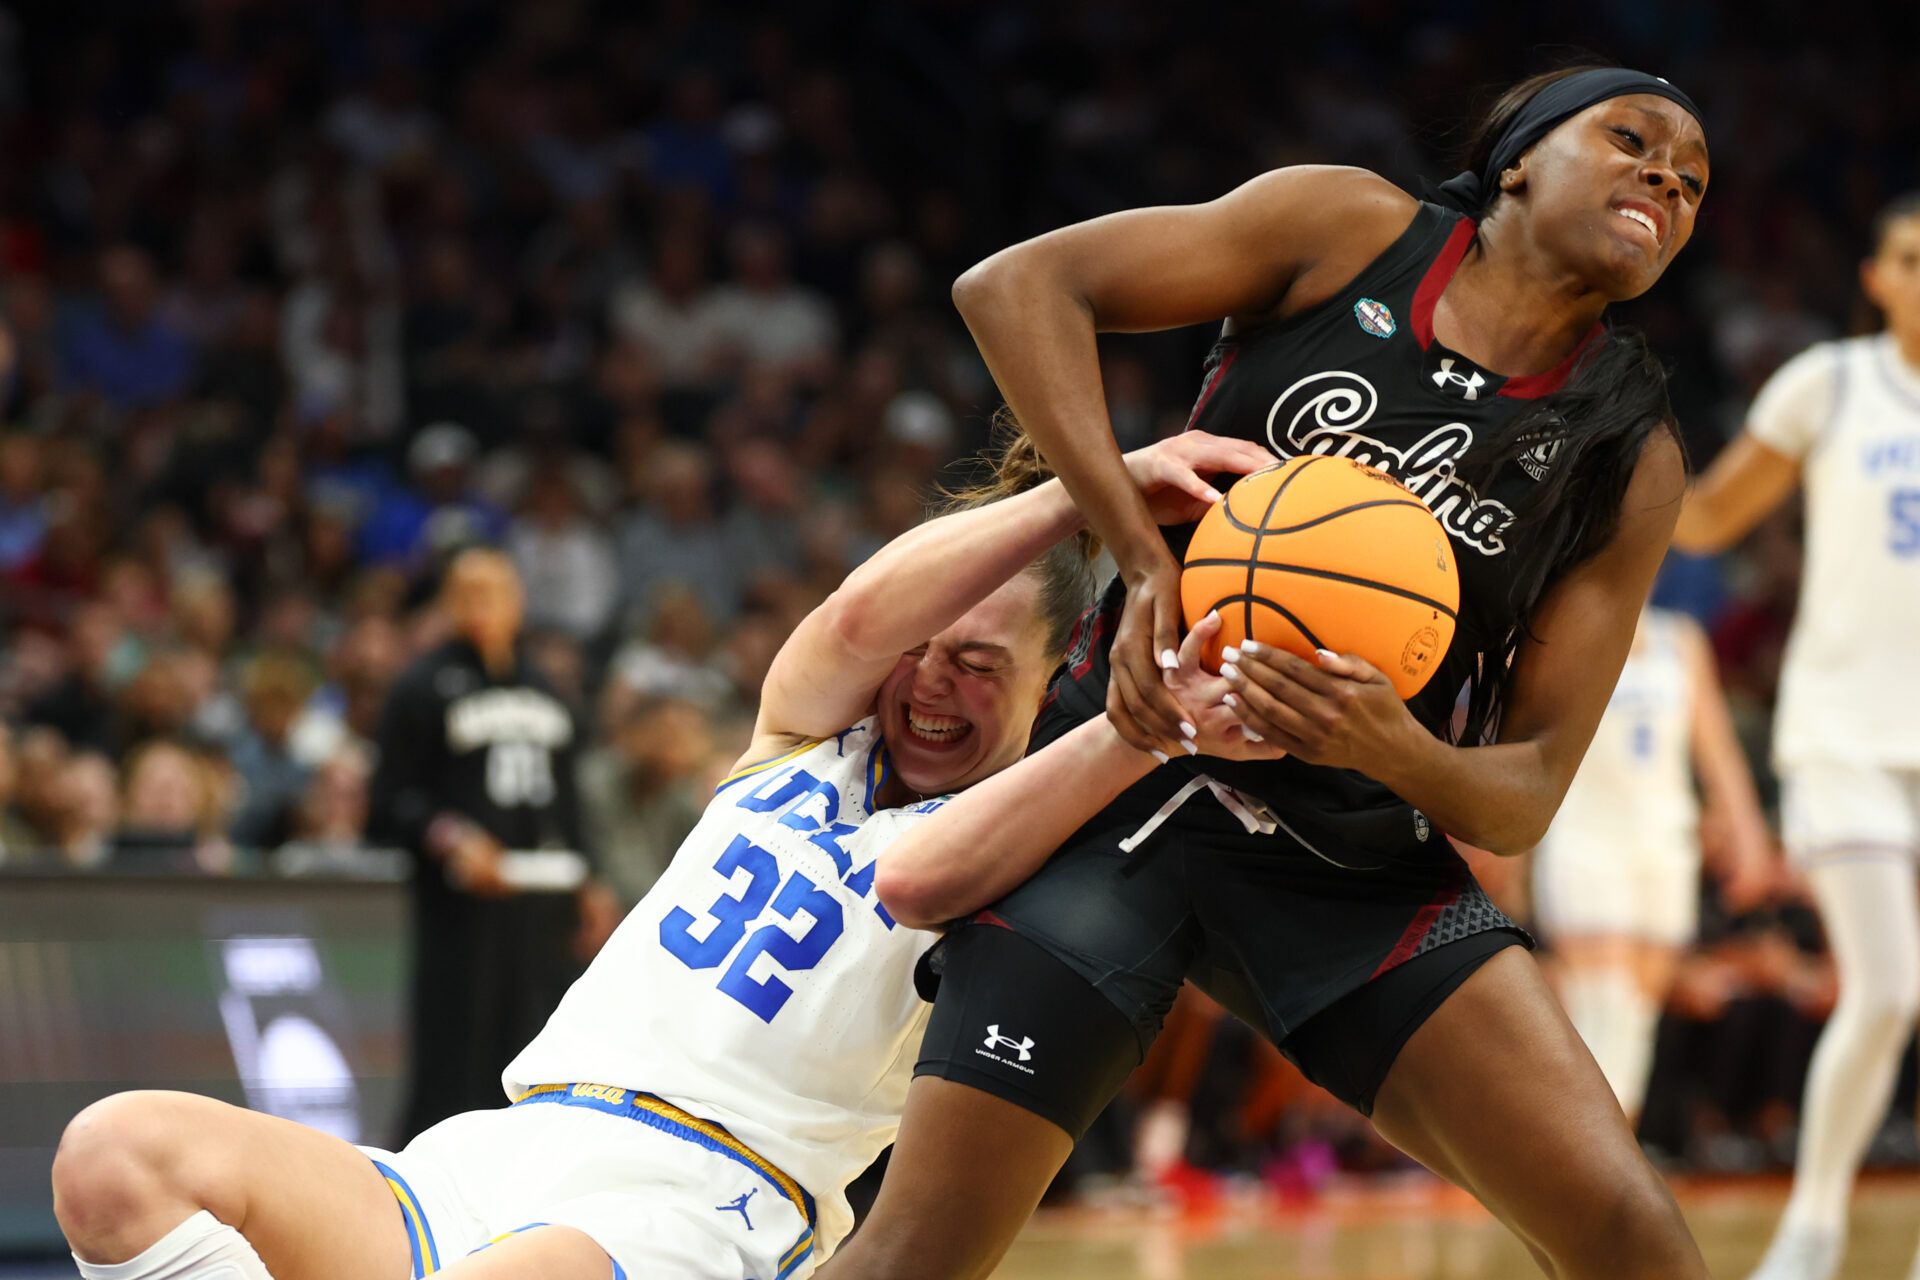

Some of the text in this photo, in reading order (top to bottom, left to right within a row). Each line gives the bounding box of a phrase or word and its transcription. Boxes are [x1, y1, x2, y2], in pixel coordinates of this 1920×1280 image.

[659, 833, 844, 1024] 32
[975, 1048, 1035, 1075] UNDER ARMOUR
